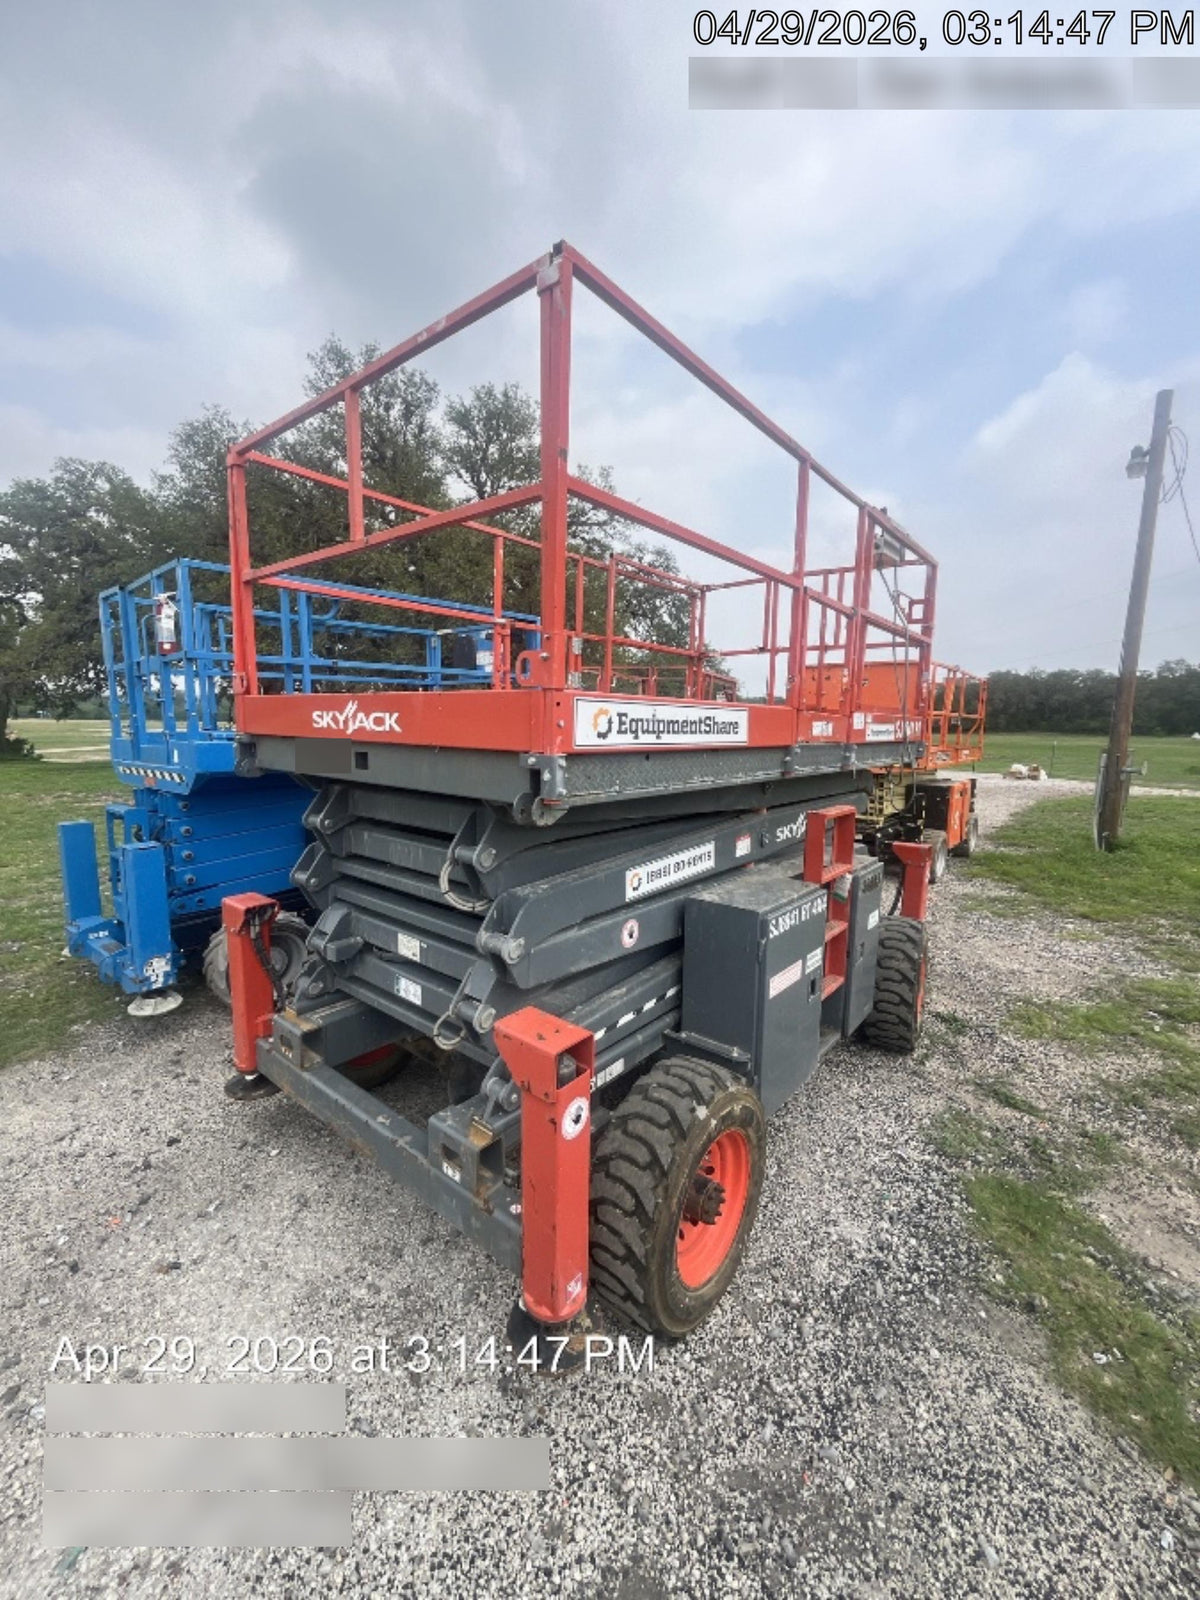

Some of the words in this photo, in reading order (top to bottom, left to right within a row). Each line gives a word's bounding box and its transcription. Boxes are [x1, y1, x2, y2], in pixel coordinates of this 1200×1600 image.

[312, 699, 402, 735] SKYJACK
[616, 711, 739, 740] EquipmentShare
[775, 811, 807, 842] SKYJ
